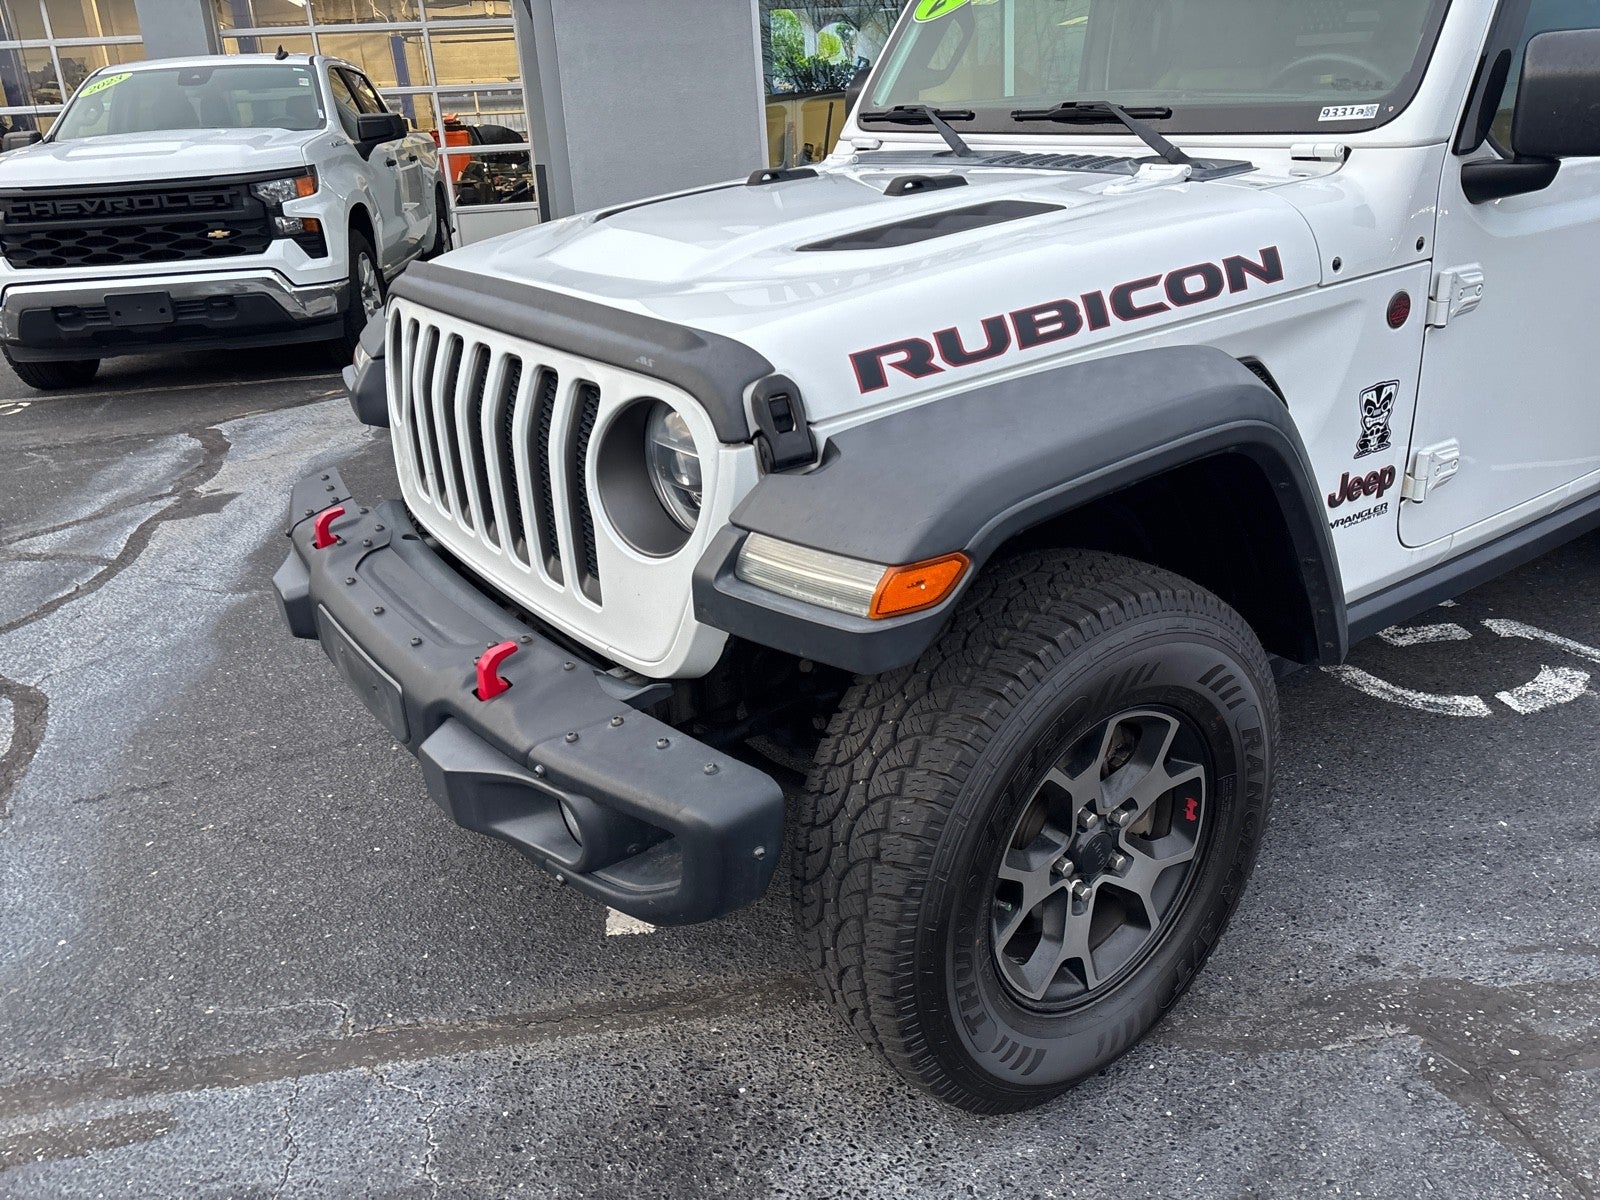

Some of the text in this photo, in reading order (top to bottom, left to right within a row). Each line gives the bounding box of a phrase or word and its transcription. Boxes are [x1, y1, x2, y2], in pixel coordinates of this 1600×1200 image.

[88, 74, 123, 94] 2023
[1321, 106, 1365, 118] 9331a
[7, 189, 239, 218] CHEVROLET
[848, 245, 1285, 394] RUBICON
[1327, 464, 1396, 509] Jeep
[1343, 509, 1388, 529] UNLIMITED
